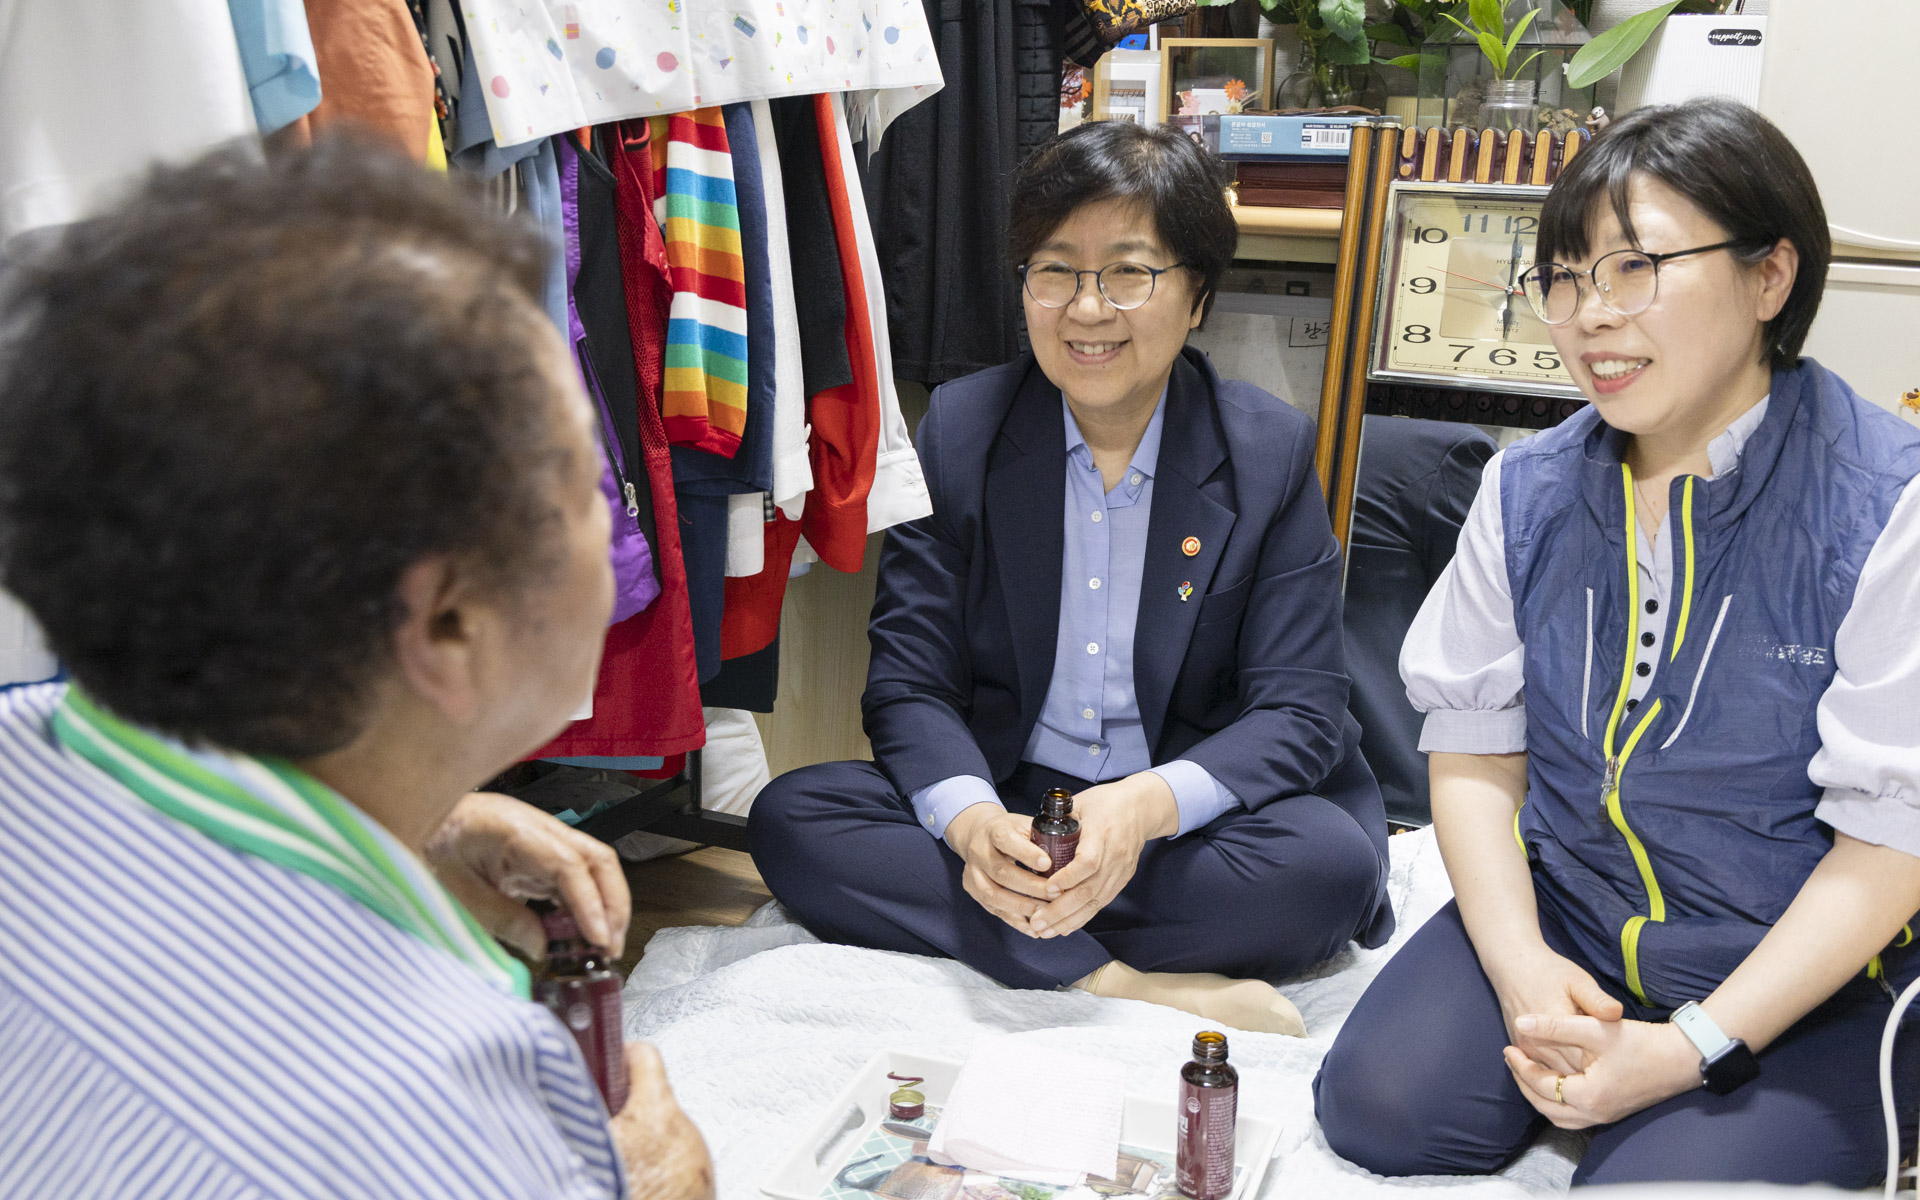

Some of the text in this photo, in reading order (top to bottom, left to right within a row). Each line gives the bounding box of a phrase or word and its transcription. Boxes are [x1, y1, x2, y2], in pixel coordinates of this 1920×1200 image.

[1712, 33, 1757, 44] support you
[1462, 213, 1489, 232] 11
[1504, 215, 1539, 235] 12
[1413, 226, 1448, 244] 10
[1409, 276, 1437, 294] 9
[1402, 324, 1431, 344] 8
[1448, 344, 1475, 363] 7
[1488, 348, 1517, 366] 6
[1532, 350, 1561, 370] 5
